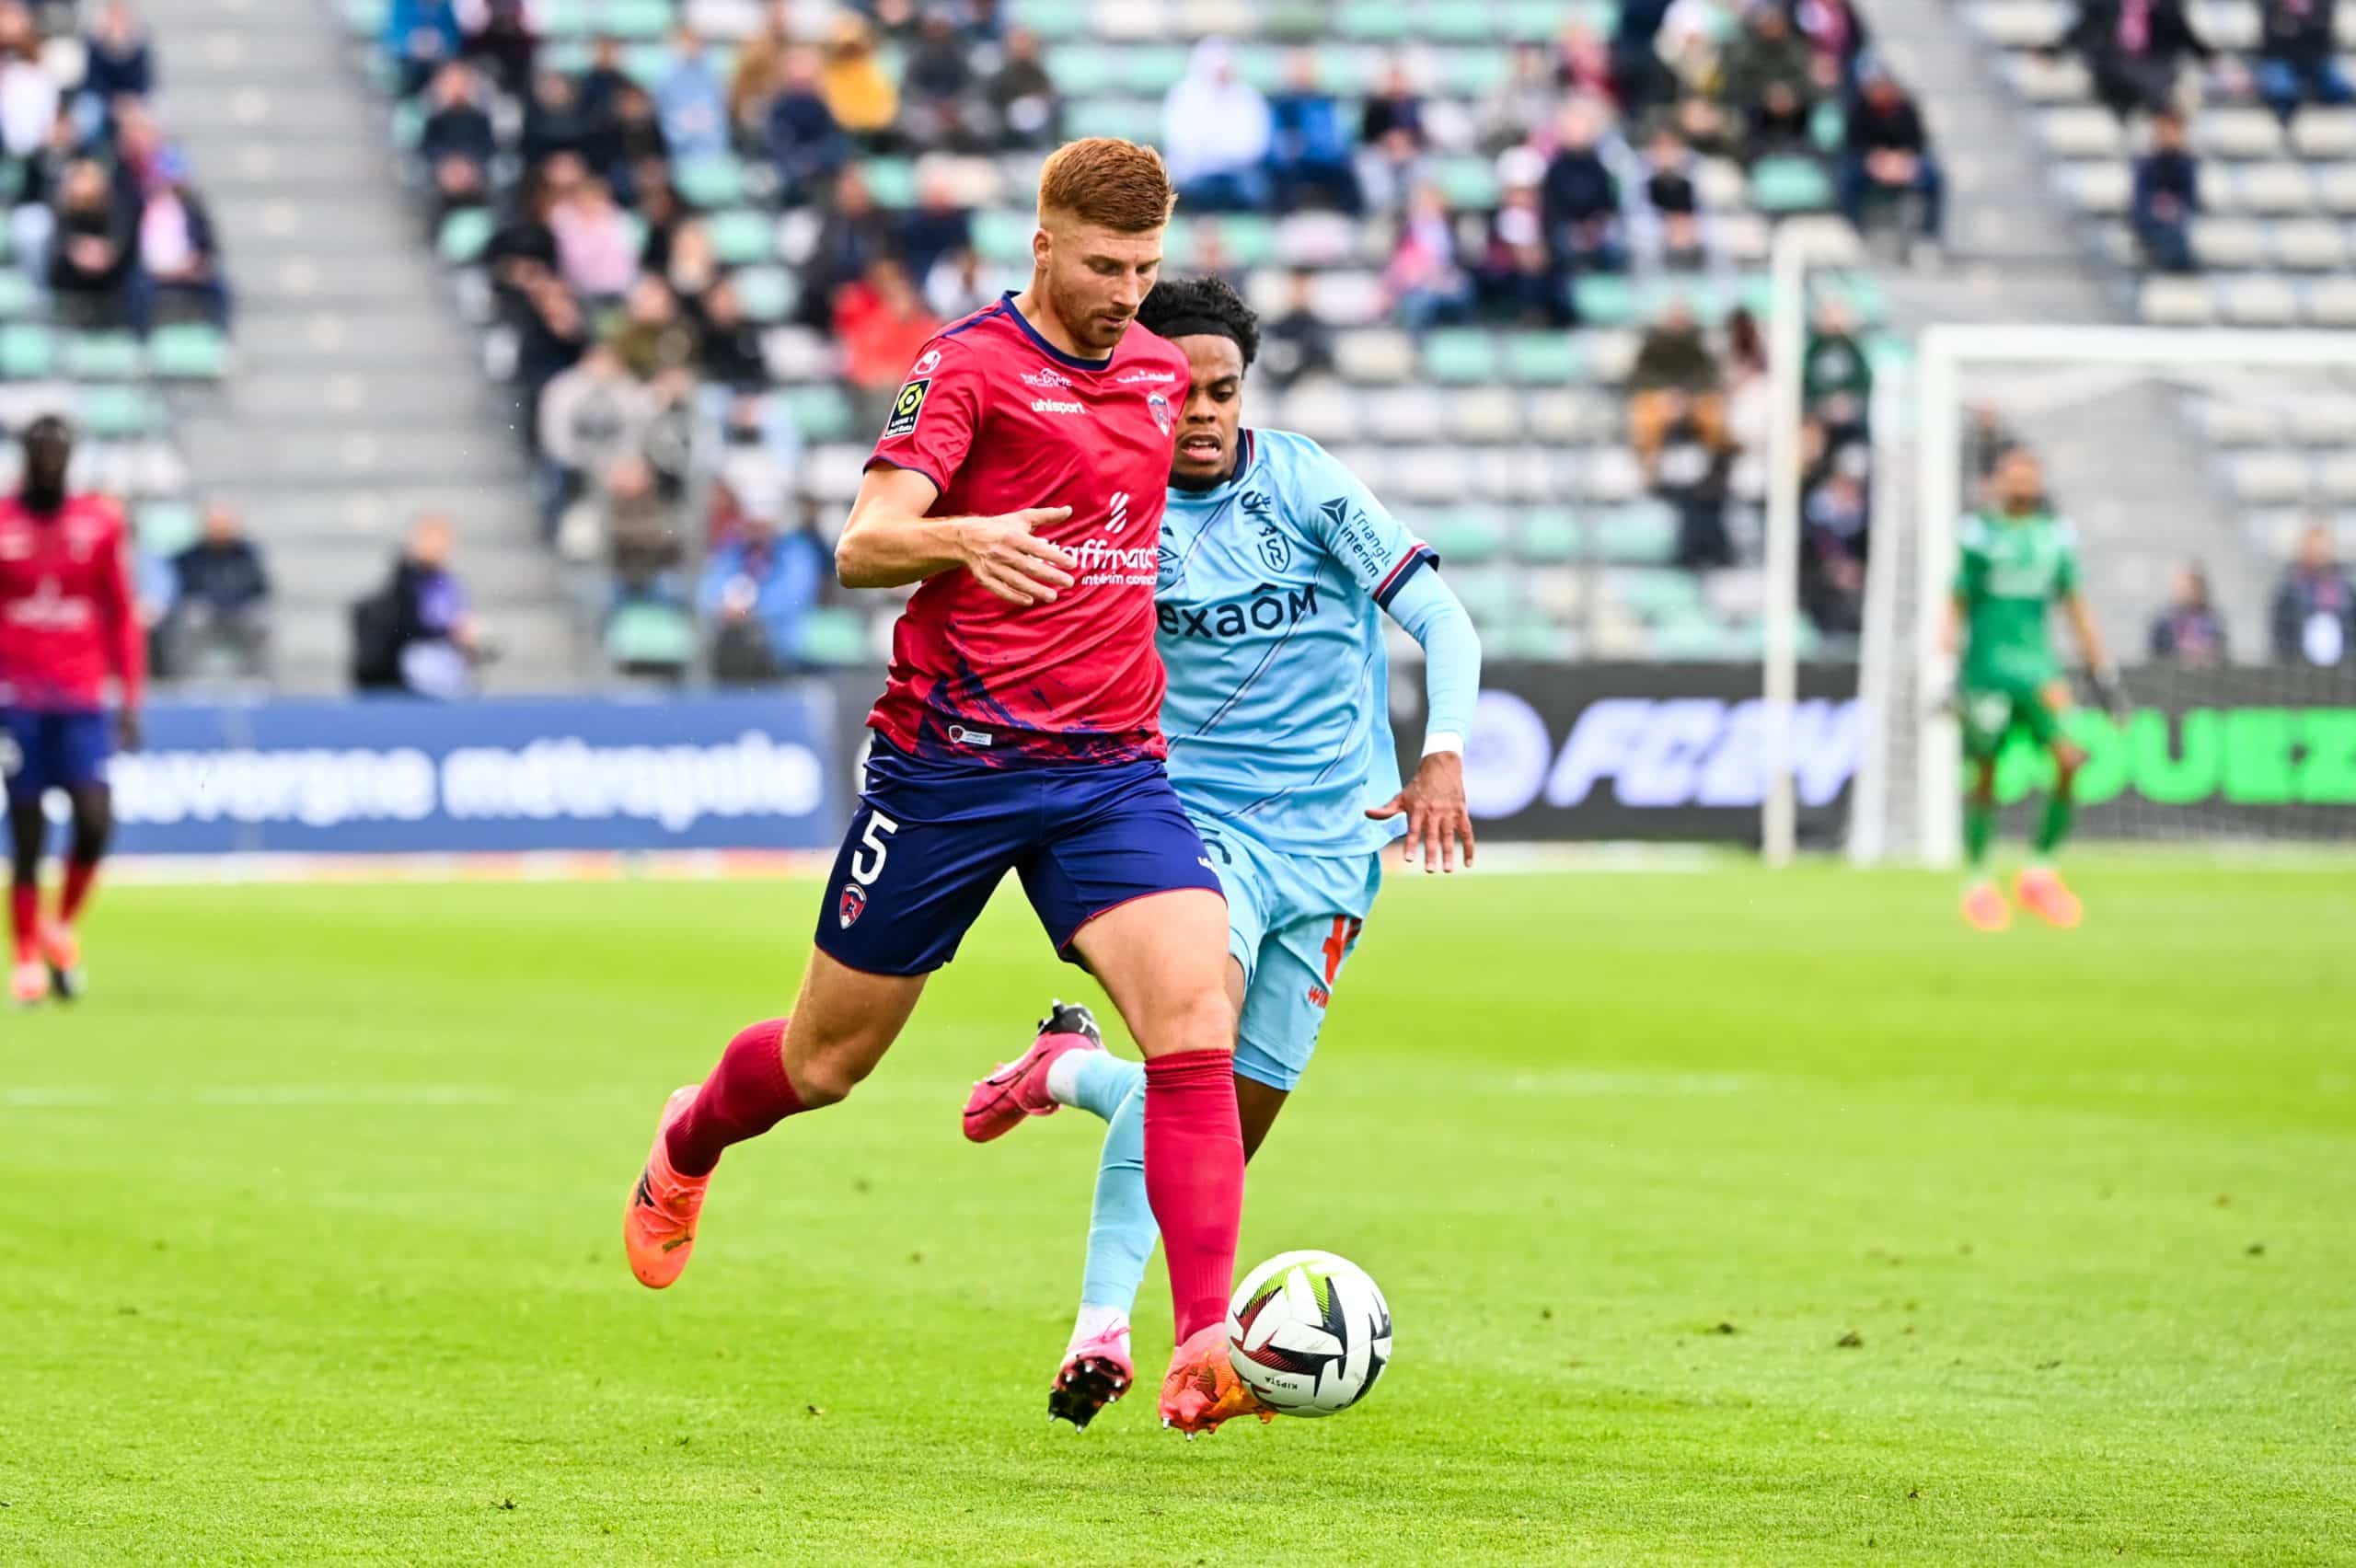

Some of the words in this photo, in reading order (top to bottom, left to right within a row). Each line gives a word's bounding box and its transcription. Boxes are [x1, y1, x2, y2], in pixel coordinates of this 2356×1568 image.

[1032, 398, 1087, 415] uhlsport
[851, 810, 899, 885] 5
[1265, 1376, 1298, 1390] KIPSTA
